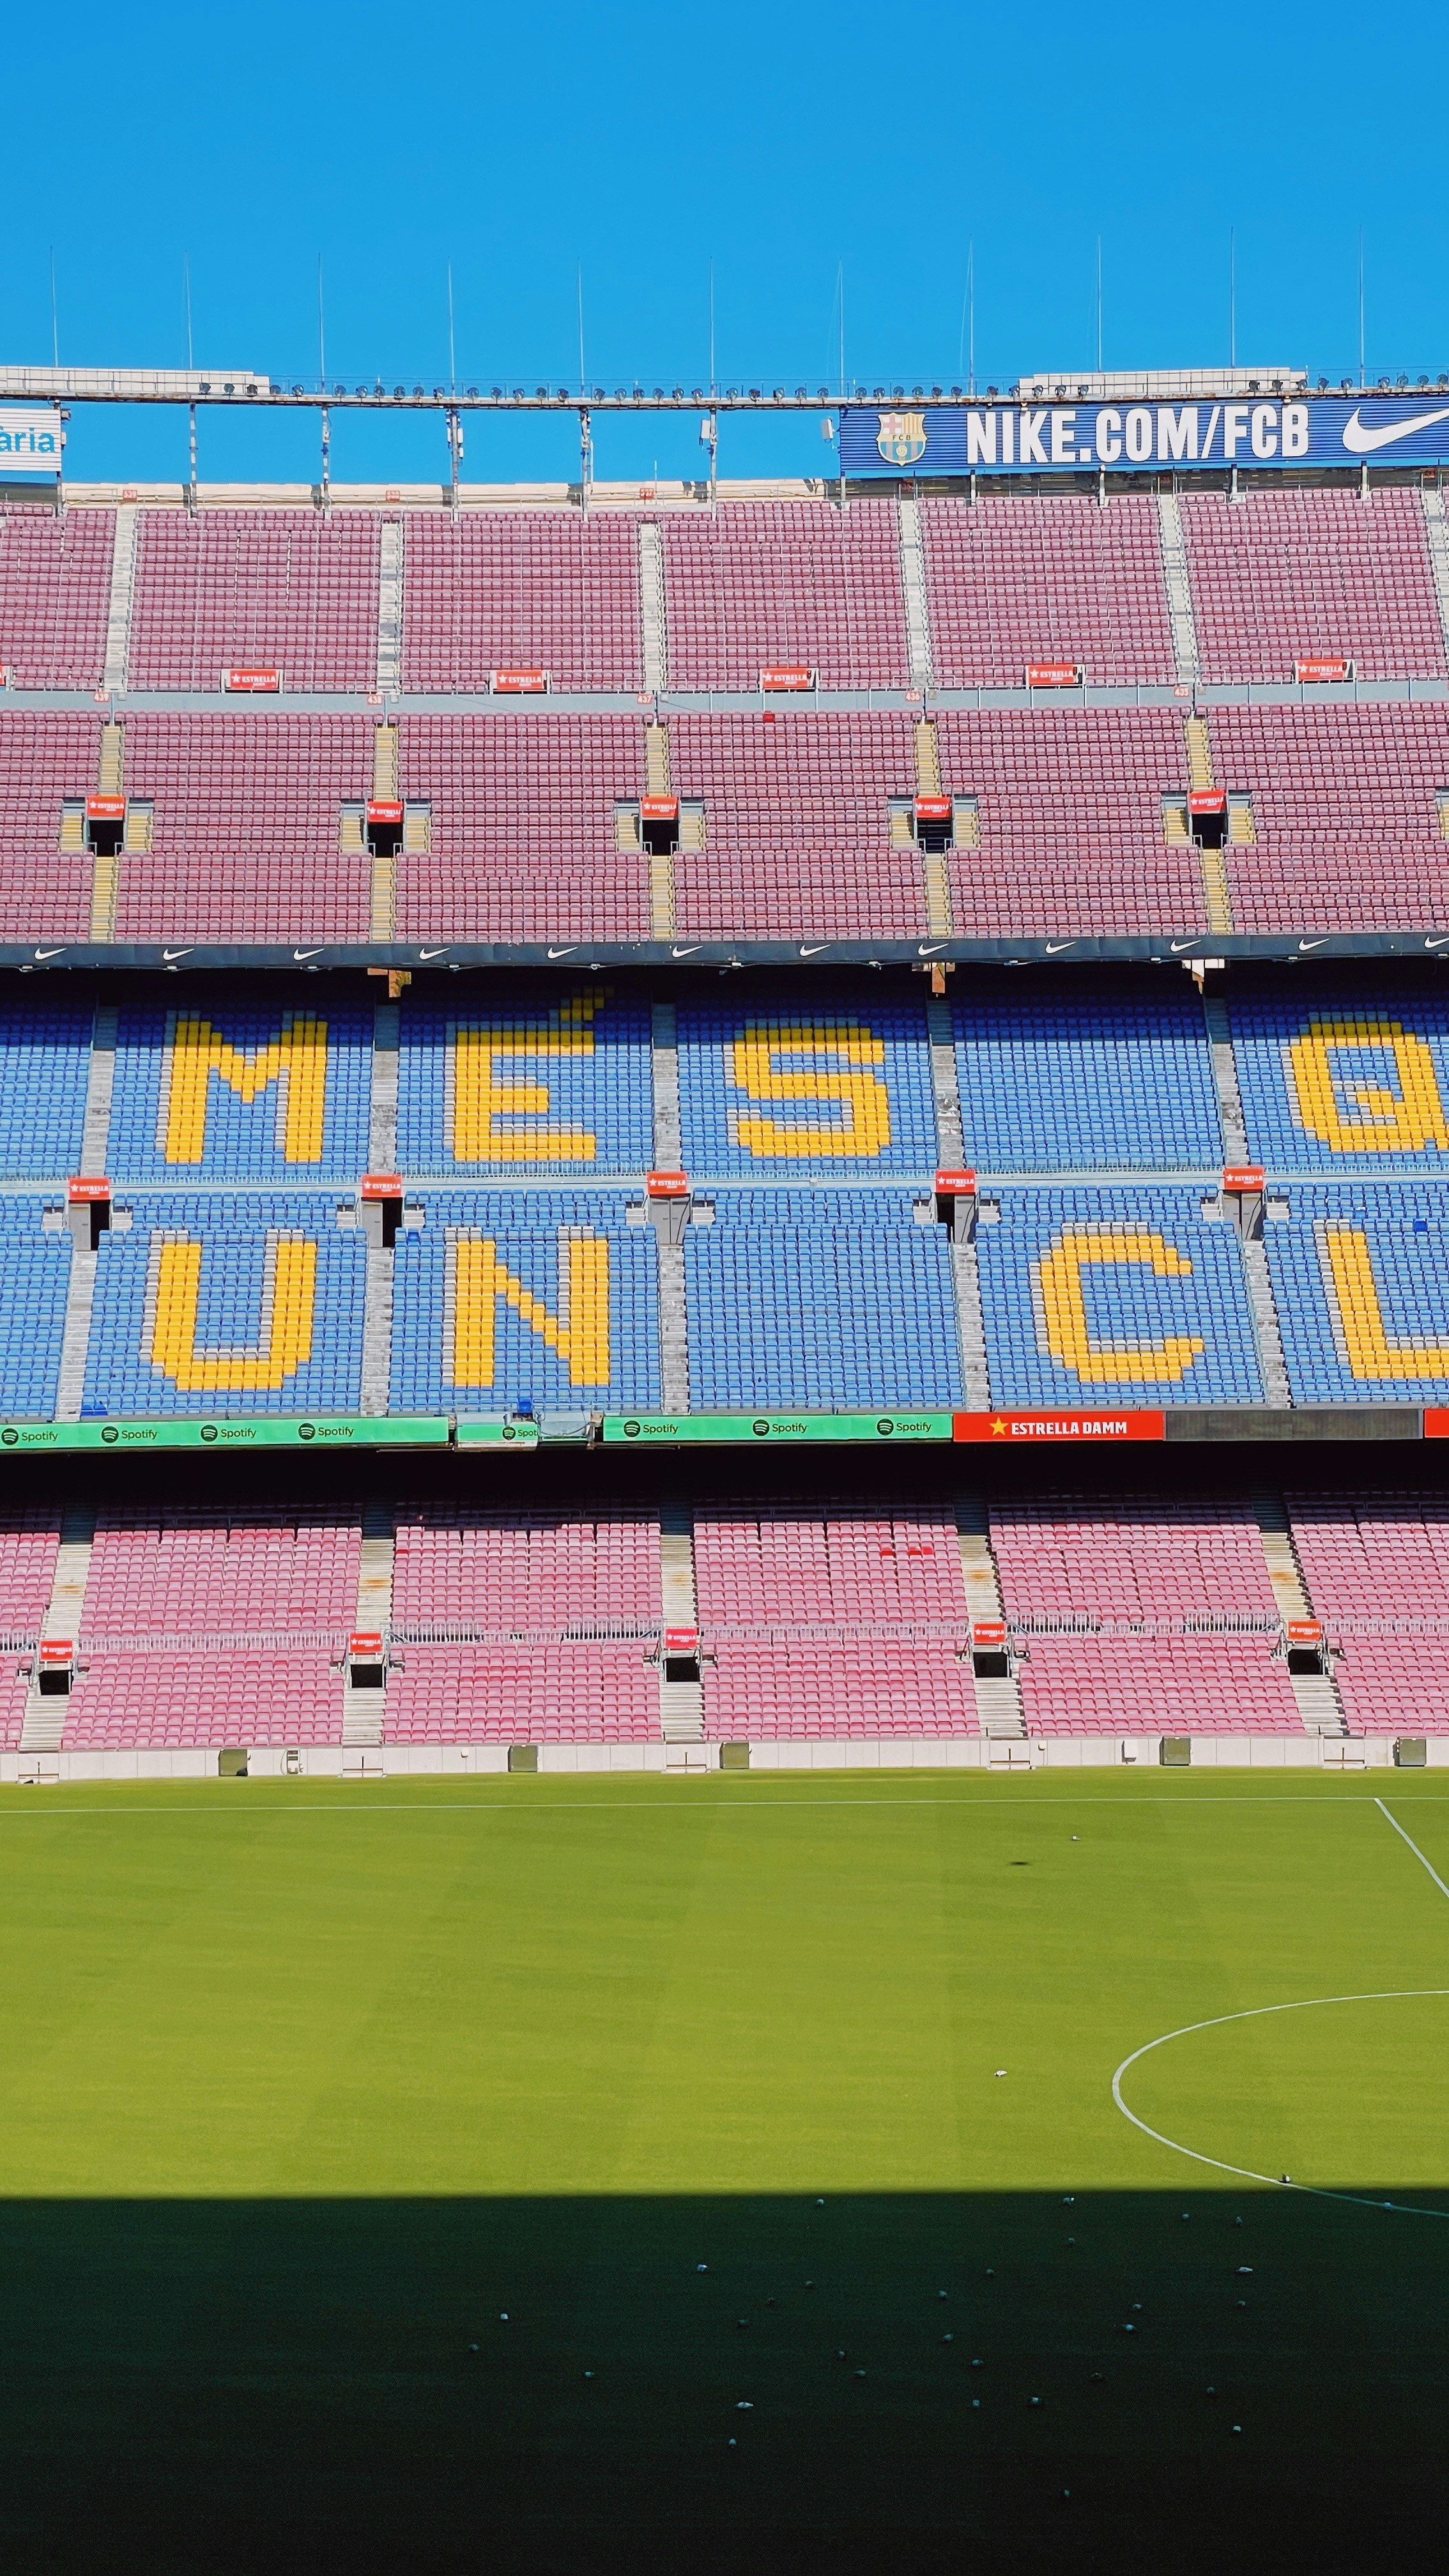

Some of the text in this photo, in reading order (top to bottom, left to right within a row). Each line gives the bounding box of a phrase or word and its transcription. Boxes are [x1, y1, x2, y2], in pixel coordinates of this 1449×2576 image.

[967, 404, 1309, 464] NIKE.COM/FCB
[1175, 687, 1189, 696] 435
[161, 989, 891, 1163] MÉS
[151, 1238, 611, 1392] UN
[318, 1427, 353, 1437] Spotify
[643, 1424, 678, 1434] Spotify
[772, 1423, 807, 1433] Spotify
[896, 1422, 931, 1432] Spotify
[1011, 1421, 1127, 1436] ESTRELLA DAMM
[22, 1432, 57, 1442] Spotify
[121, 1430, 157, 1440] Spotify
[221, 1428, 256, 1438] Spotify
